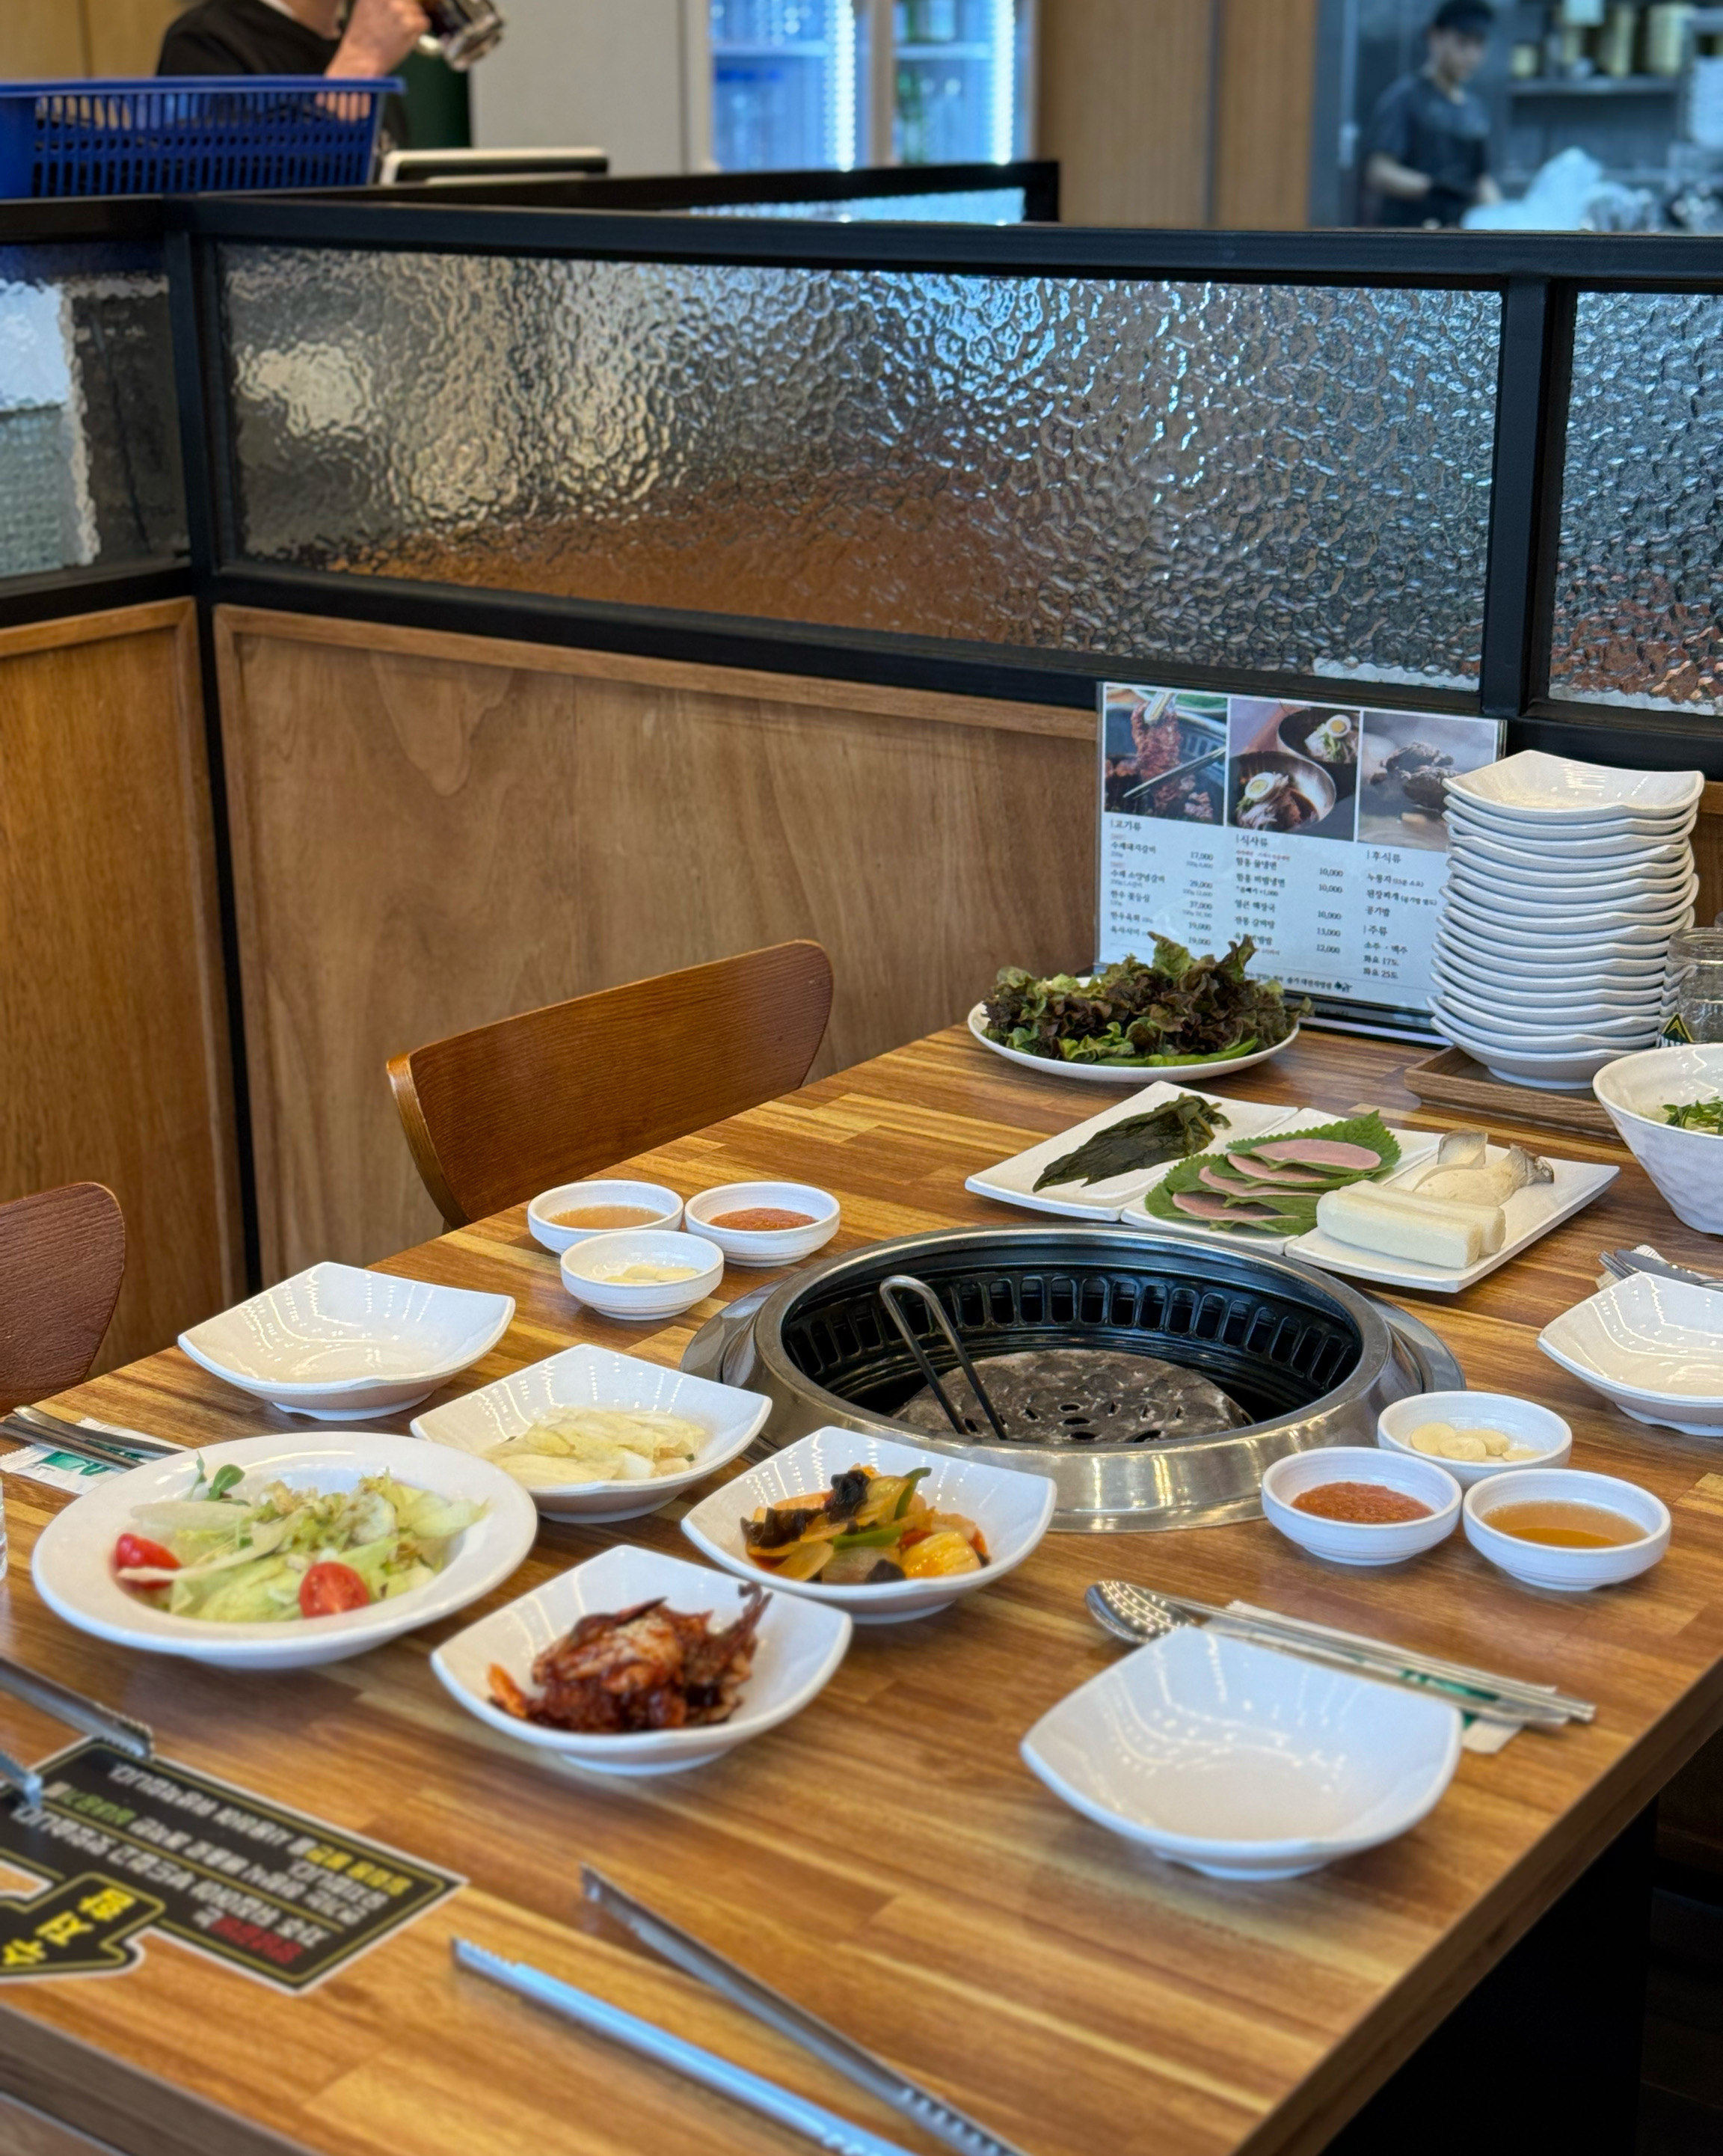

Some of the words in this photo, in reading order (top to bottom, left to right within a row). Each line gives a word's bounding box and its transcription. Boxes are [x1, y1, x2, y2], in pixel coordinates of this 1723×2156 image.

[1115, 820, 1142, 831] 고기류
[1241, 835, 1268, 847] 식사류
[1191, 852, 1214, 861] 17,000
[1372, 851, 1401, 864] 후식류
[1254, 859, 1277, 870] 물냉면
[1320, 867, 1343, 877] 10,000
[1367, 873, 1392, 883] 누룽지
[1254, 876, 1286, 888] 비빔냉면
[1318, 884, 1342, 894] 10,000
[1253, 902, 1275, 912] 해장국
[1318, 910, 1342, 920] 10,000
[1366, 906, 1390, 917] 공기밥
[1252, 918, 1274, 930] 갈비탕
[1369, 925, 1387, 936] 주류
[1316, 944, 1340, 953] 12,000
[1364, 942, 1380, 950] 소주
[1392, 945, 1408, 954] 맥주
[108, 1841, 195, 1891] 부드럽고
[2, 1888, 138, 1966] 수저함
[274, 1916, 329, 1948] 자주
